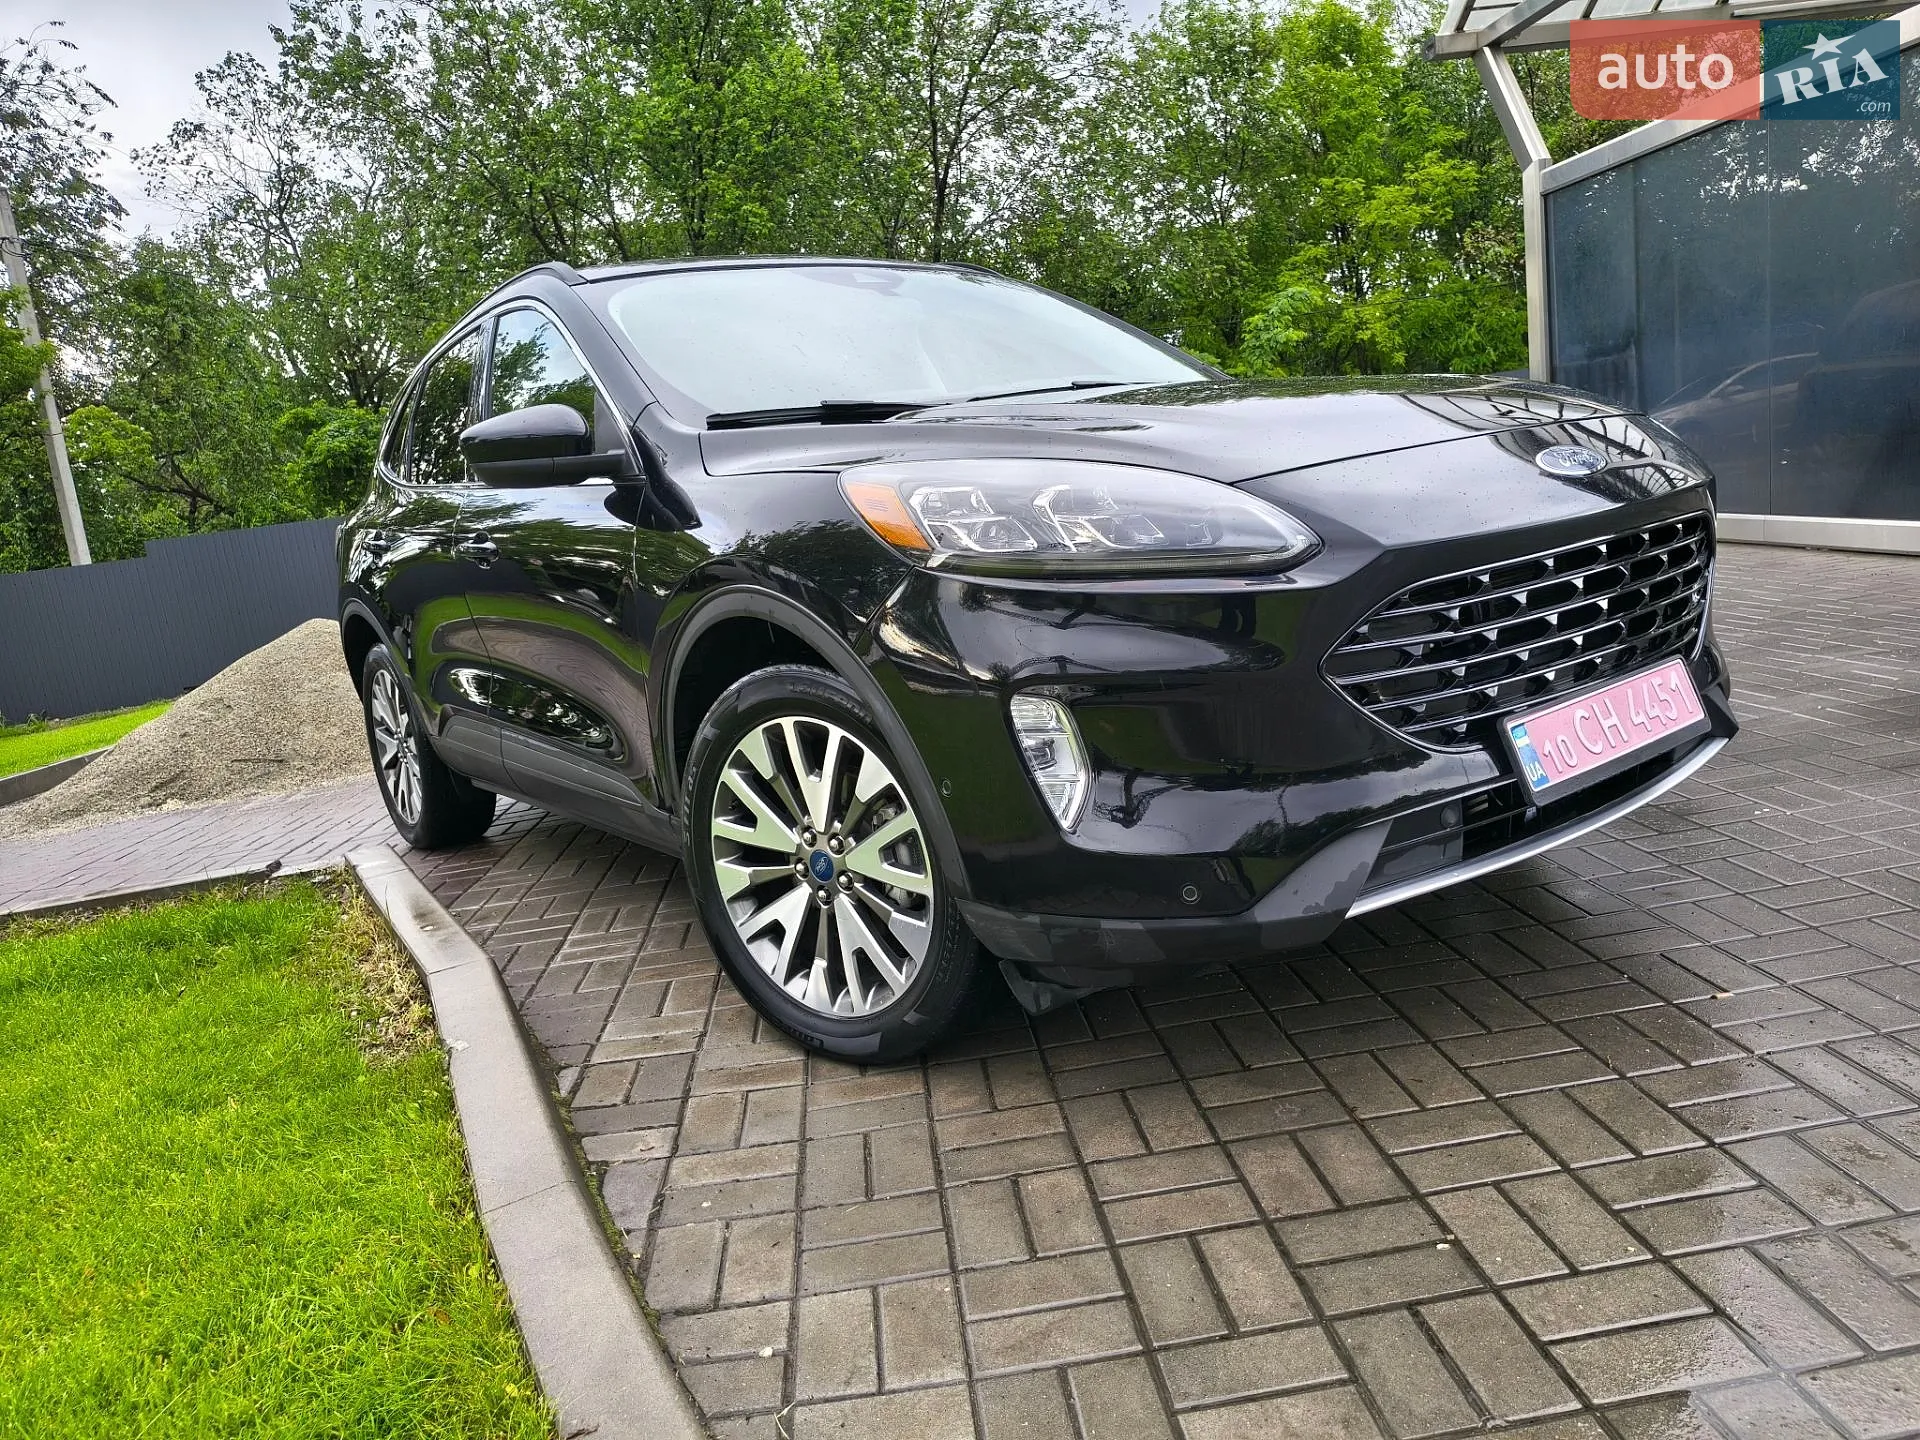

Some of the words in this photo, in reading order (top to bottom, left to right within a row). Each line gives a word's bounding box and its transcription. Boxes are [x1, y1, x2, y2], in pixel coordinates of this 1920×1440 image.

[1542, 734, 1579, 774] 10
[1573, 698, 1629, 755] CH
[1628, 671, 1694, 733] 4451
[1525, 761, 1547, 782] UA
